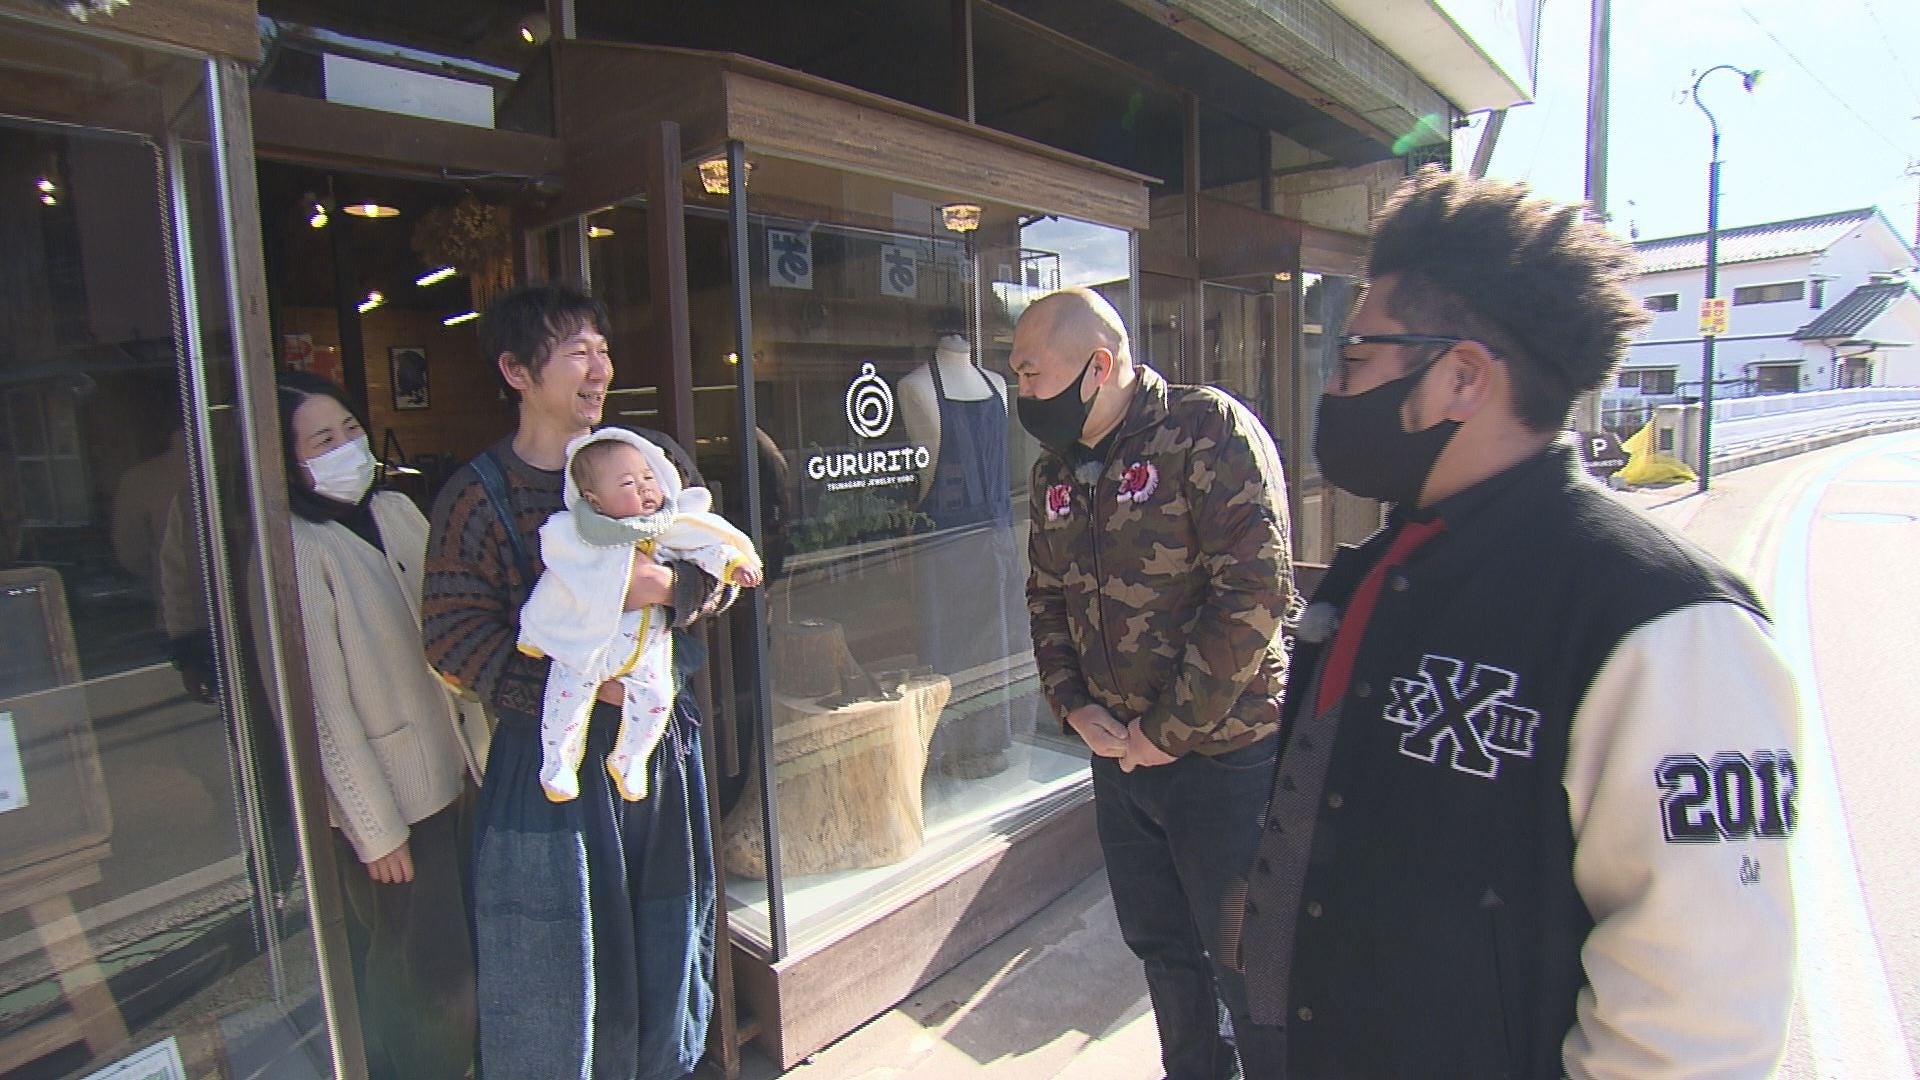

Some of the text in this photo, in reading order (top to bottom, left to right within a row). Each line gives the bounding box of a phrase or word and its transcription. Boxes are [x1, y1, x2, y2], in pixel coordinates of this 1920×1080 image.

[1591, 438, 1607, 457] P
[807, 446, 930, 480] GURURITO
[867, 477, 897, 488] JEWELRY
